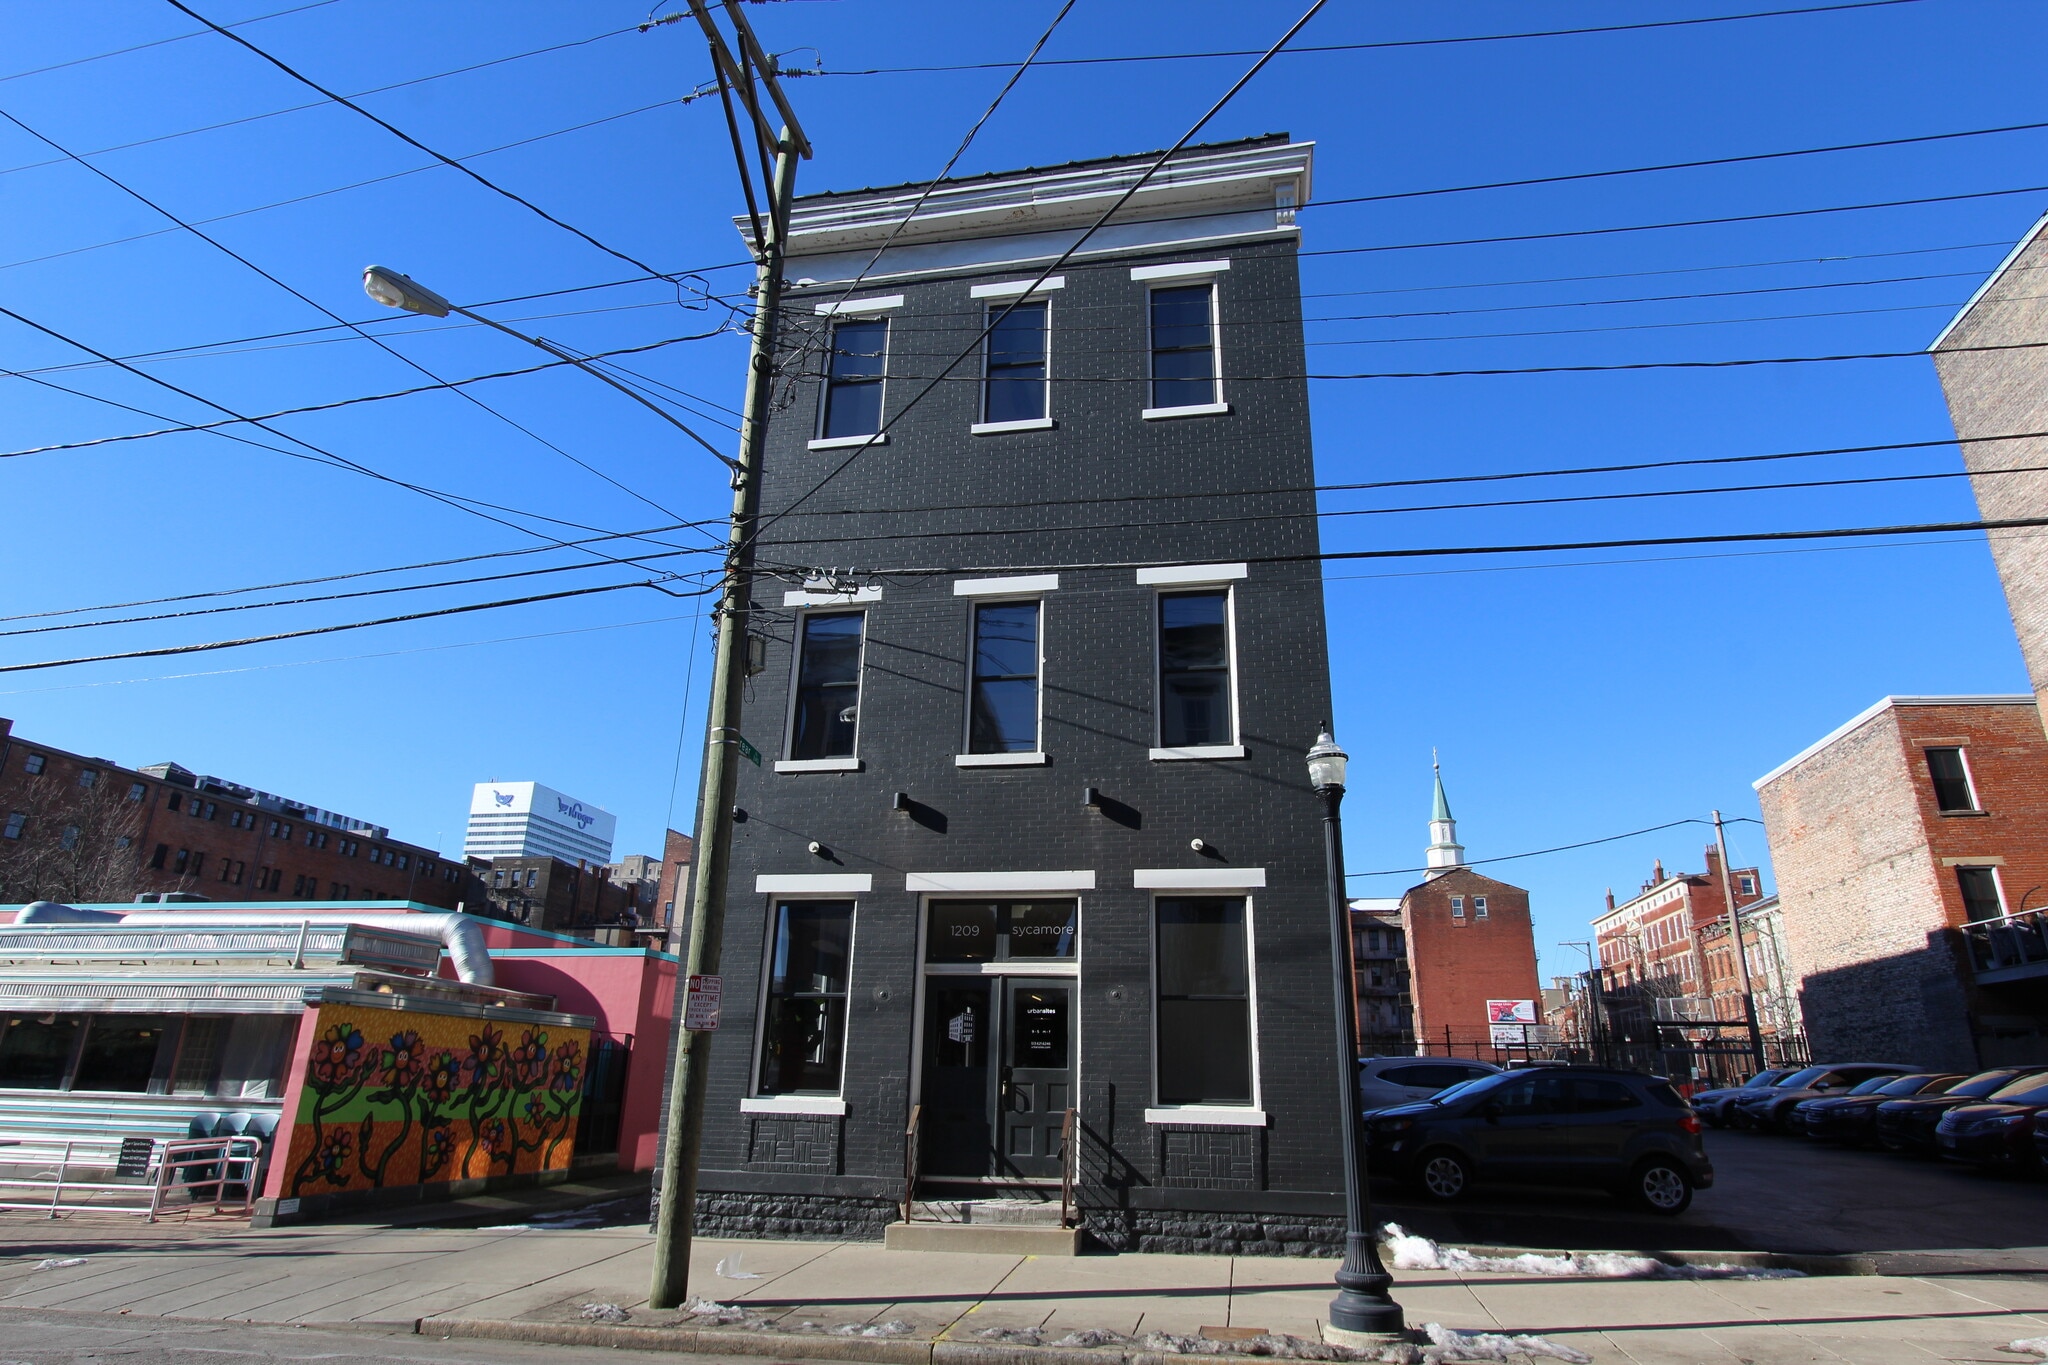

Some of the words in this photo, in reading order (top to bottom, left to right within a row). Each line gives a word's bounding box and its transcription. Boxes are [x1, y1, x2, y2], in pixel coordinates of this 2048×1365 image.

[568, 803, 595, 829] Kroger
[951, 925, 980, 937] 1209
[1012, 924, 1074, 937] sycamore
[690, 979, 700, 989] NO
